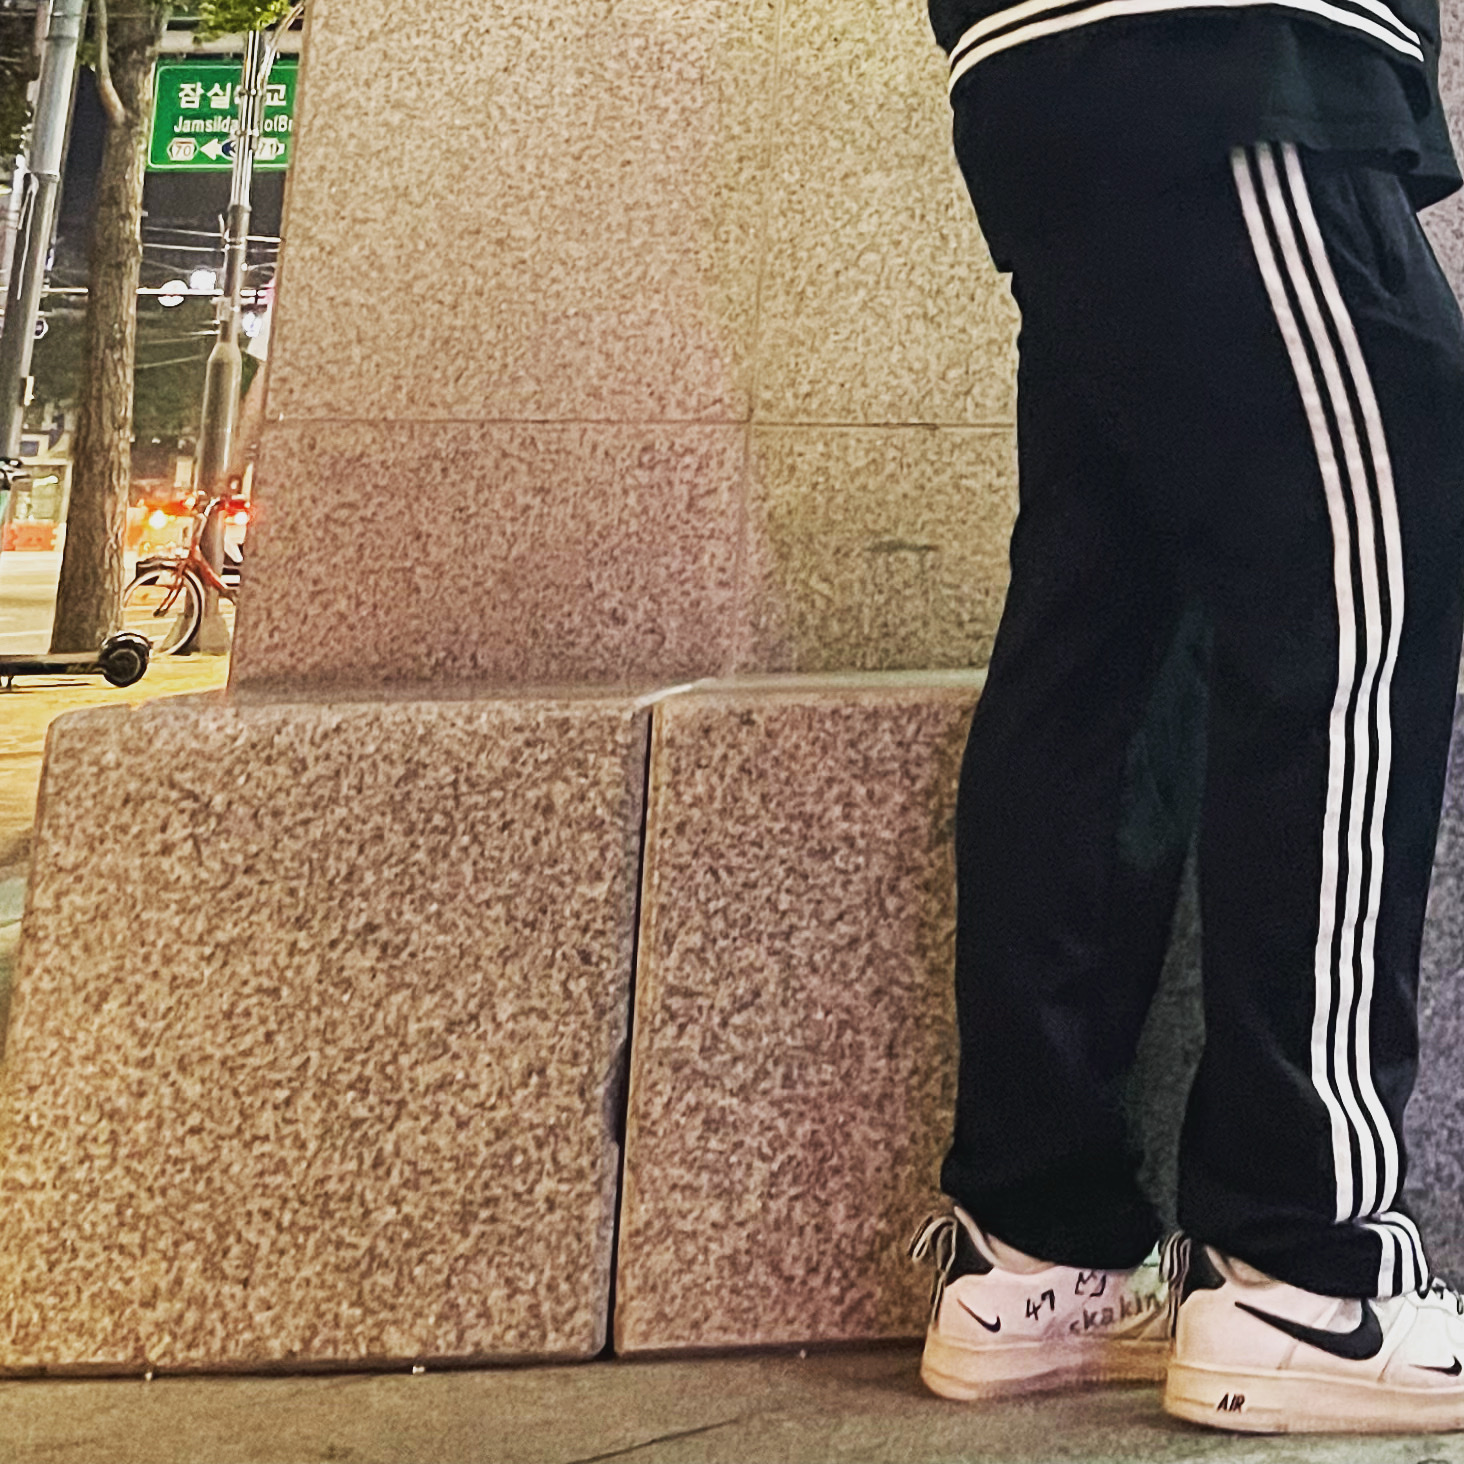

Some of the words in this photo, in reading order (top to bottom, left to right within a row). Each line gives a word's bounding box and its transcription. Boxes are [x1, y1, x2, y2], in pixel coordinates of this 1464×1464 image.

[178, 81, 287, 109] 잠실교
[175, 145, 193, 157] 70
[1216, 1391, 1246, 1414] AIR
